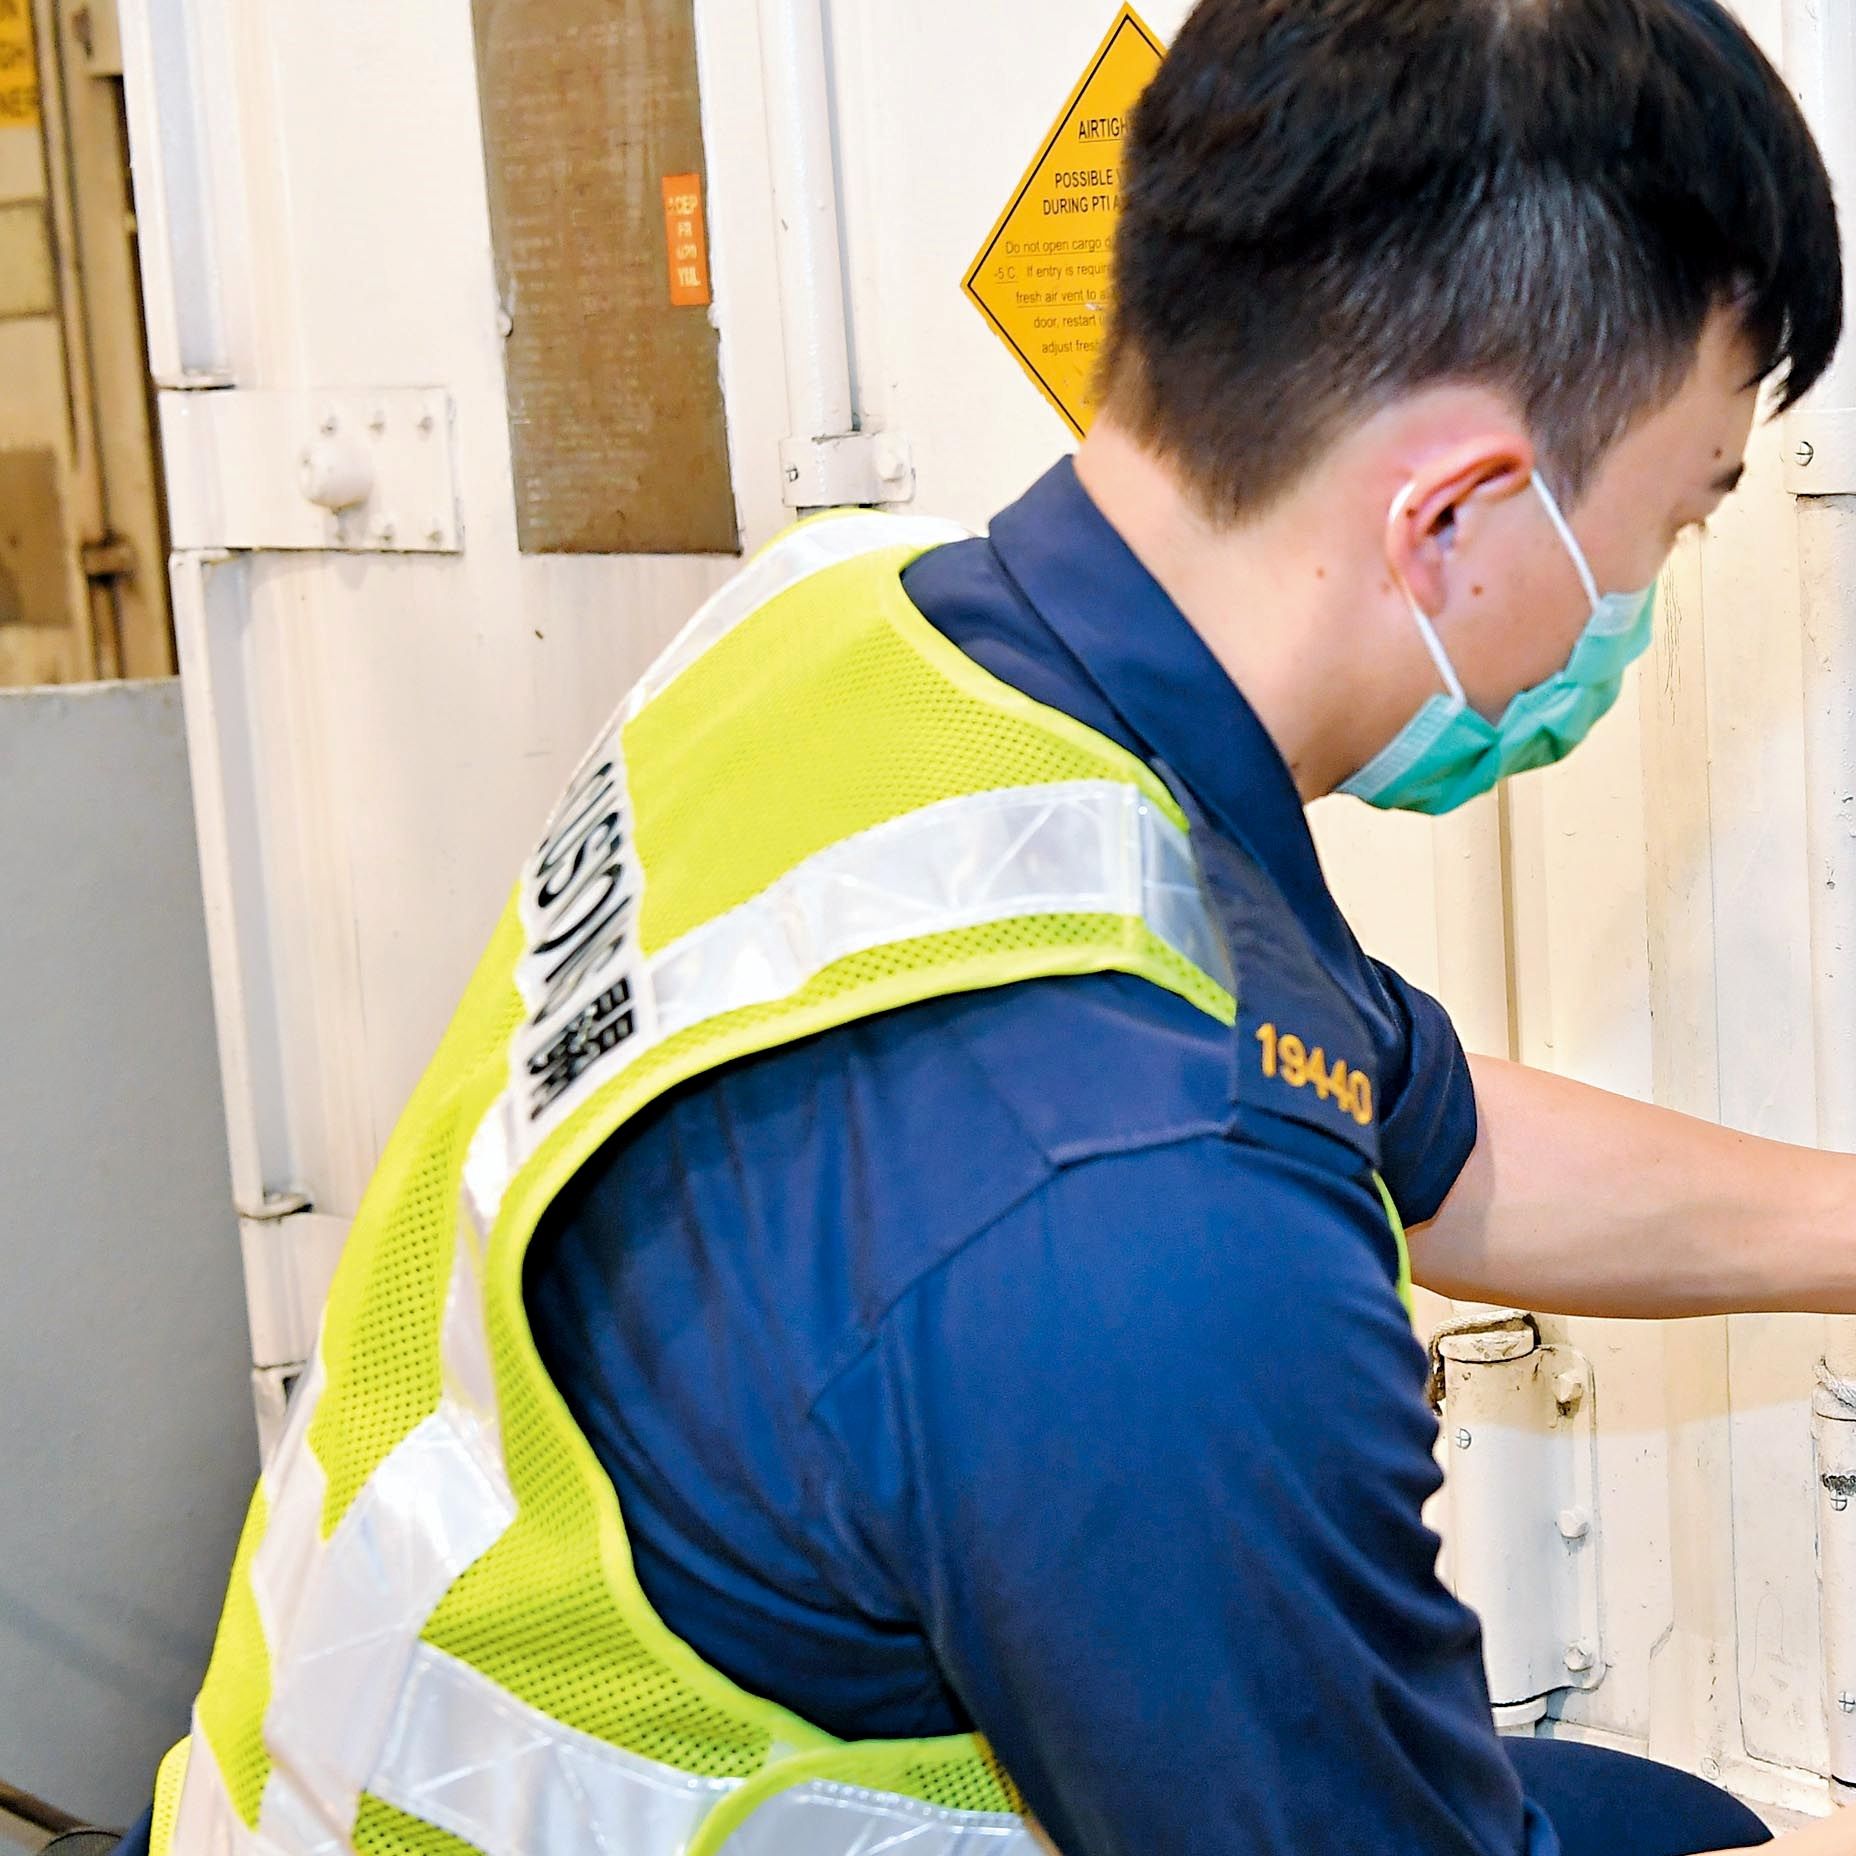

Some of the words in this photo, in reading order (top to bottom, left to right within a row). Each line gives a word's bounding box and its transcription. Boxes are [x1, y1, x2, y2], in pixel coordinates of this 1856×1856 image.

[1055, 168, 1113, 188] POSSIBLE
[1042, 196, 1088, 216] DURING
[1091, 195, 1110, 212] PTI
[1006, 241, 1020, 254] Do
[1024, 239, 1040, 253] not
[1042, 239, 1069, 254] open
[1072, 237, 1102, 252] cargo
[1008, 266, 1016, 279] C
[1027, 265, 1033, 277] If
[1037, 266, 1061, 280] entry
[1066, 266, 1074, 276] is
[1016, 291, 1040, 303] fresh
[1045, 291, 1058, 302] air
[1062, 290, 1083, 301] vent
[1087, 289, 1097, 300] to
[1063, 315, 1096, 327] restart
[1042, 341, 1073, 356] adjust
[1255, 1022, 1373, 1126] 19440
